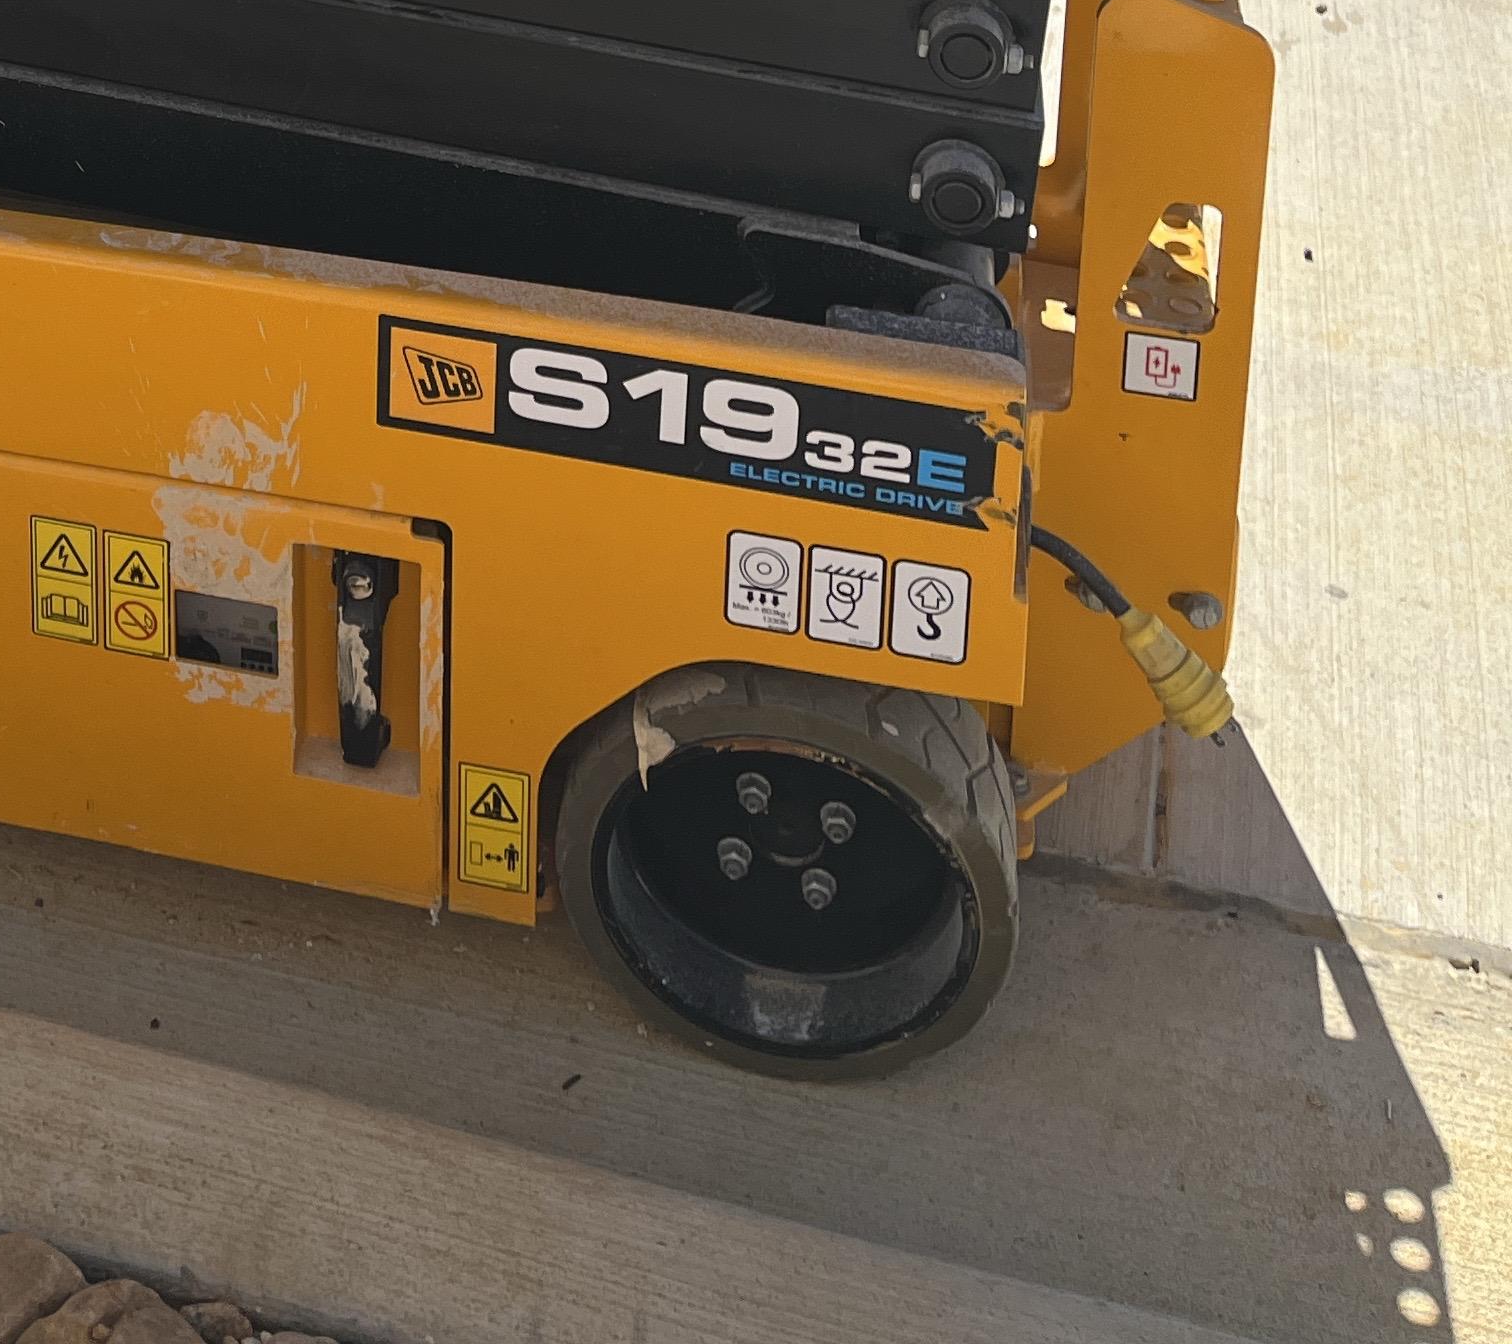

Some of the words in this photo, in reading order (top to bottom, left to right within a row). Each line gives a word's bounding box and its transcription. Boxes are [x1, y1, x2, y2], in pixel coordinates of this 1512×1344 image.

[416, 353, 475, 399] JCB
[730, 462, 867, 498] ELECTRIC
[875, 486, 964, 516] DRIVE
